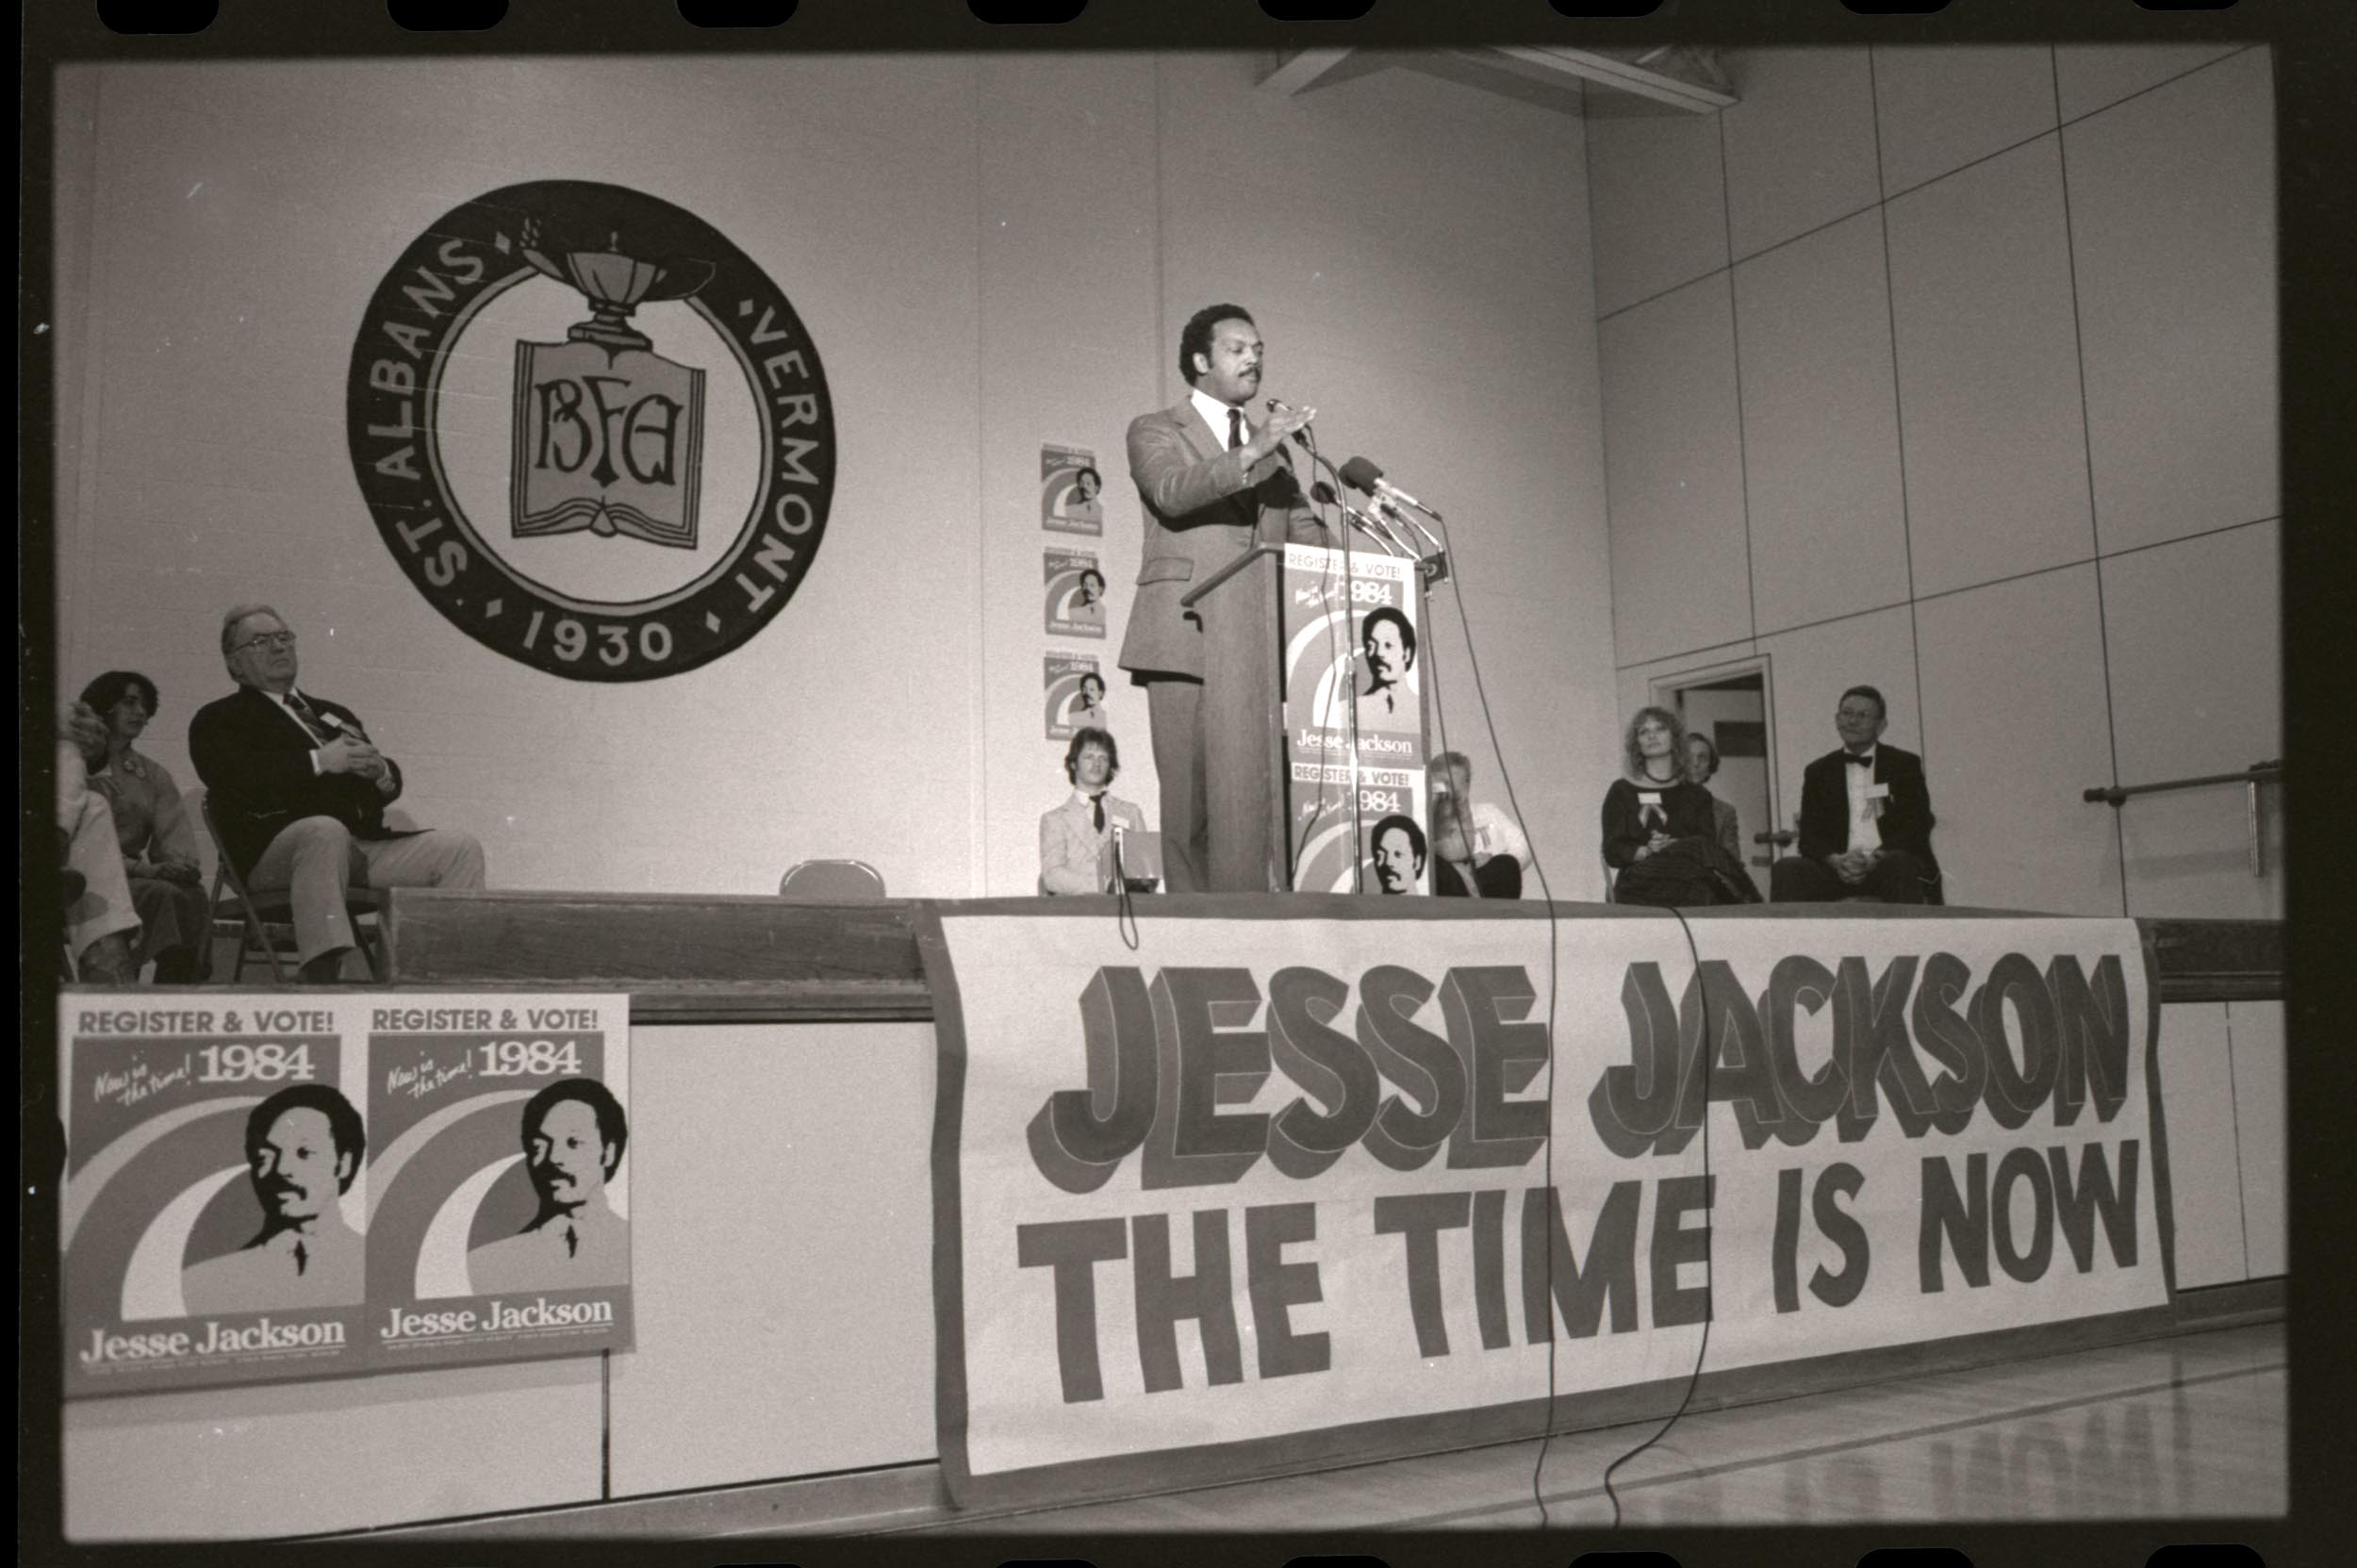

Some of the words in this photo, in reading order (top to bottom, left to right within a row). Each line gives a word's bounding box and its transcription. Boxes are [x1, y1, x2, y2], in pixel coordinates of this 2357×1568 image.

[369, 238, 485, 481] ALBANS
[734, 305, 820, 613] VERMONT
[1289, 553, 1346, 570] REGISE
[1364, 563, 1401, 580] VOTE!
[523, 610, 672, 666] 1930
[1345, 734, 1413, 753] ackson
[1294, 765, 1352, 783] REGSTER
[1372, 770, 1409, 785] VOTE!
[1345, 789, 1402, 814] 984
[78, 1010, 214, 1034] REGISTER
[223, 1010, 243, 1033] &
[254, 1010, 334, 1033] VOTE!
[372, 1008, 493, 1031] REGISTER
[500, 1008, 518, 1030] &
[527, 1008, 598, 1030] VOTE!
[197, 1044, 317, 1083] 1984
[478, 1040, 583, 1077] 1984
[1026, 964, 1549, 1195] JESSE
[1588, 951, 2130, 1159] JACKSON
[1016, 1201, 1331, 1404] THE
[1374, 1174, 1717, 1358] TIME
[1772, 1161, 1870, 1314] IS
[1918, 1138, 2139, 1294] NOW
[380, 1307, 476, 1339] Jesse
[482, 1297, 613, 1331] Jackson
[79, 1329, 190, 1363] Jesse
[195, 1317, 346, 1355] Jackson
